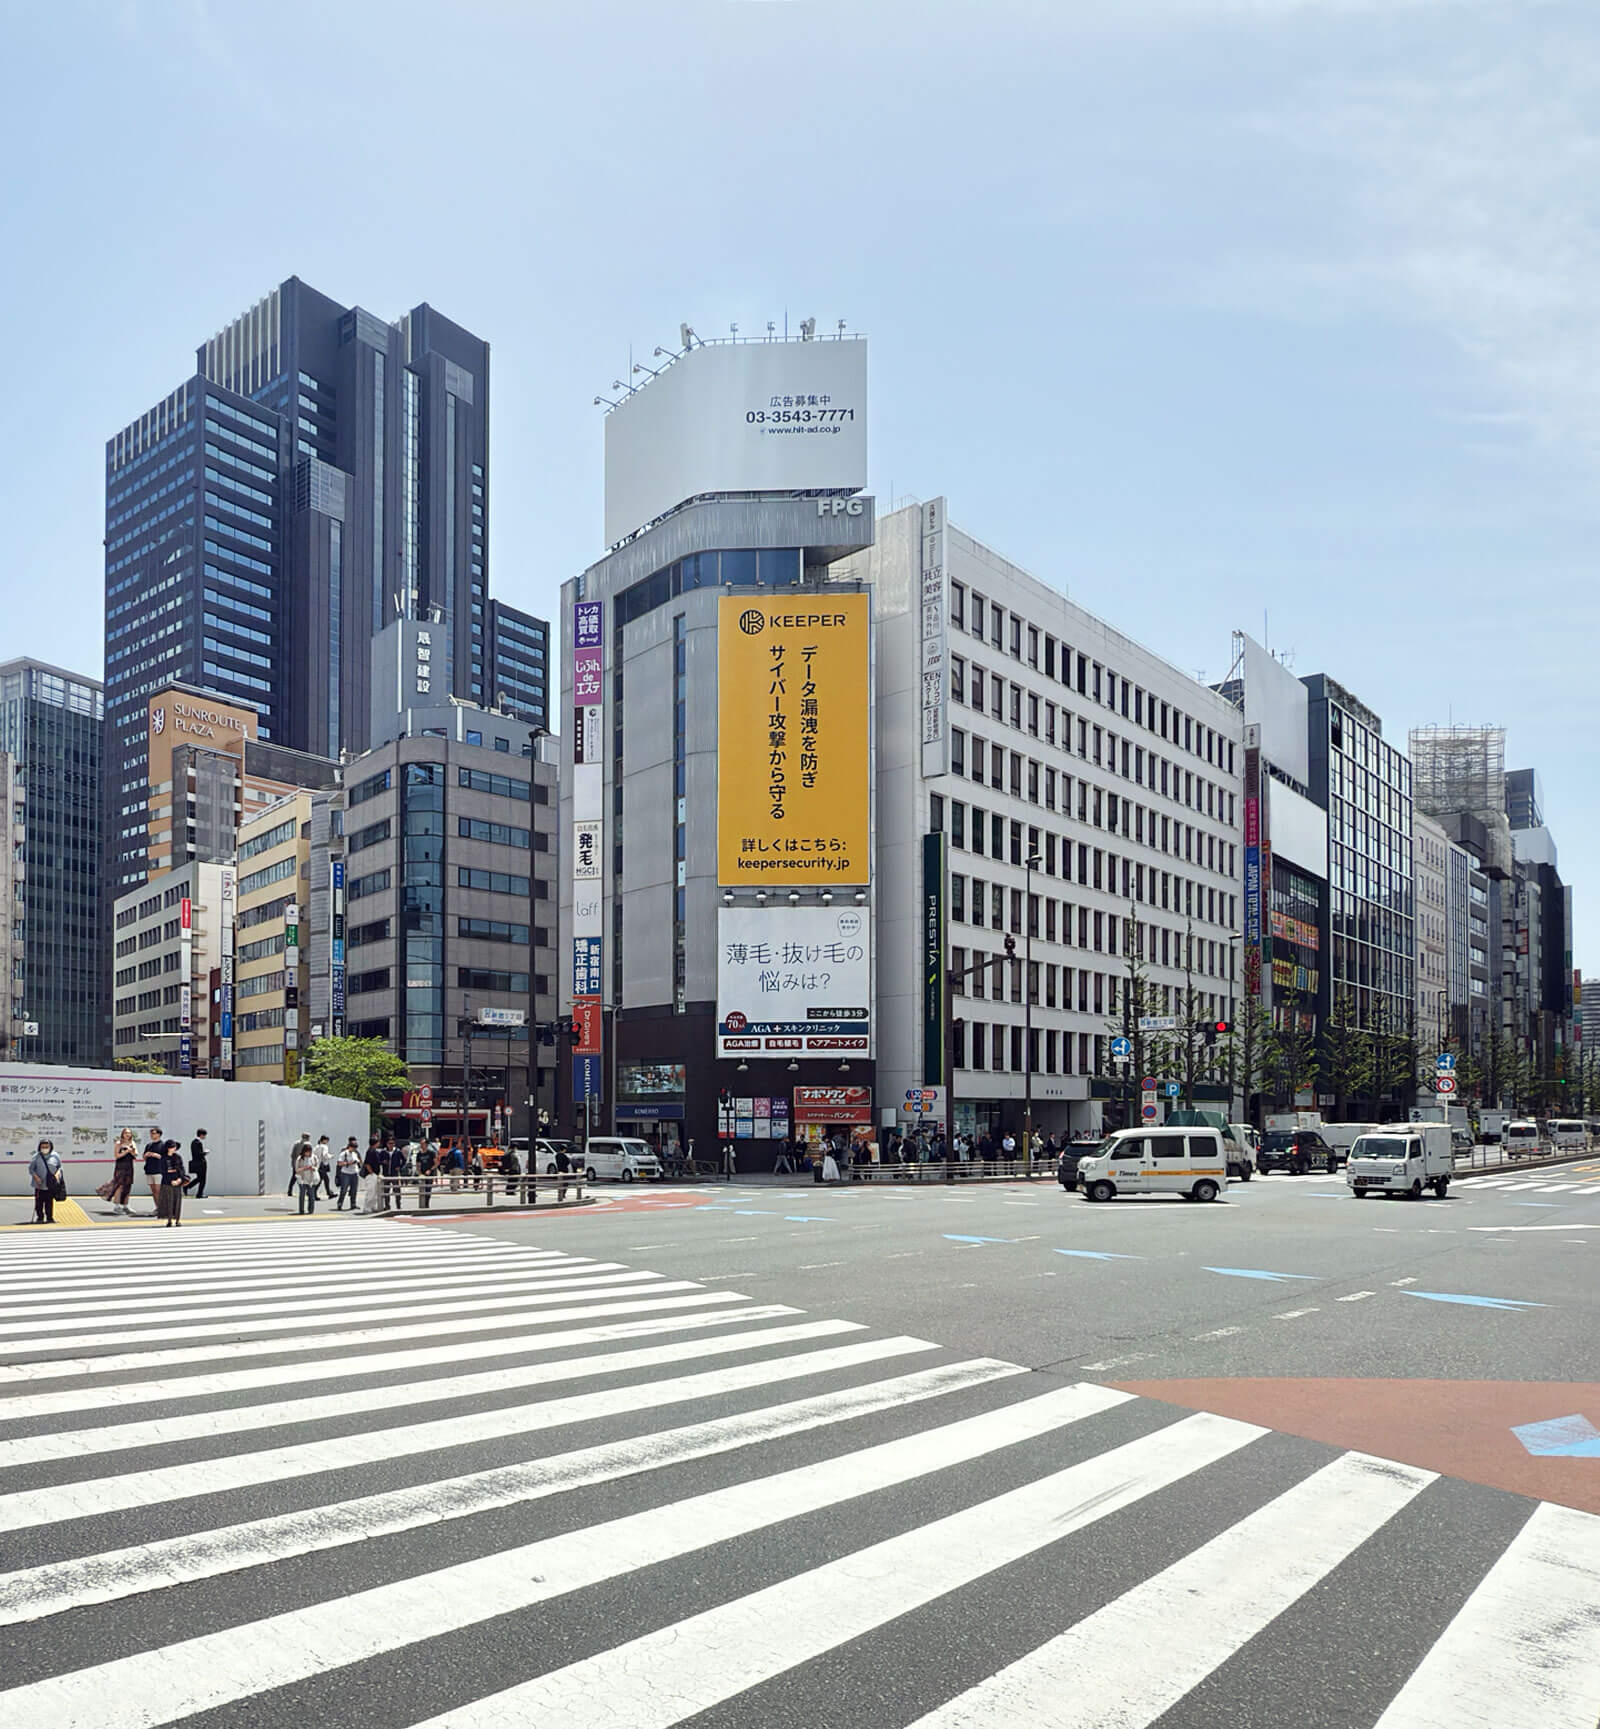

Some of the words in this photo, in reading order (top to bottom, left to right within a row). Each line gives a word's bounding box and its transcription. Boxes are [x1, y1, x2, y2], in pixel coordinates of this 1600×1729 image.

[770, 395, 831, 407] 広告募集中
[746, 409, 854, 423] 03-3543-7771
[768, 426, 841, 434] www.hit-ad.co.jp
[817, 499, 863, 517] FPG
[579, 606, 598, 615] トレカ
[770, 615, 846, 627] KEEPER
[576, 659, 600, 673] じぶん
[583, 672, 594, 681] de
[576, 681, 600, 695] エステ
[174, 702, 241, 731] SUNROUTE
[800, 646, 818, 788] データ漏洩を防ぎ
[175, 718, 215, 738] PLAZA
[769, 646, 787, 819] サイバー攻撃から守る
[579, 833, 592, 865] 発毛
[742, 838, 846, 852] 詳しくはこちら:
[737, 857, 850, 870] keepersecurity.jp
[1248, 863, 1258, 890] JAPAN
[929, 895, 938, 966] PRESTIA
[726, 942, 864, 965] 薄毛・抜け毛の
[575, 939, 588, 994] 矯正歯科
[590, 944, 600, 989] 新宿南口
[809, 1009, 864, 1017] ここから徒歩3分
[750, 1024, 771, 1033] AGA
[783, 1024, 840, 1032] スキンクリニック
[809, 1039, 865, 1047] ヘアアートメイク
[1, 1085, 91, 1095] 新宿グランドターミナル
[803, 1089, 847, 1099] ナポリタン
[1169, 1085, 1178, 1096] P
